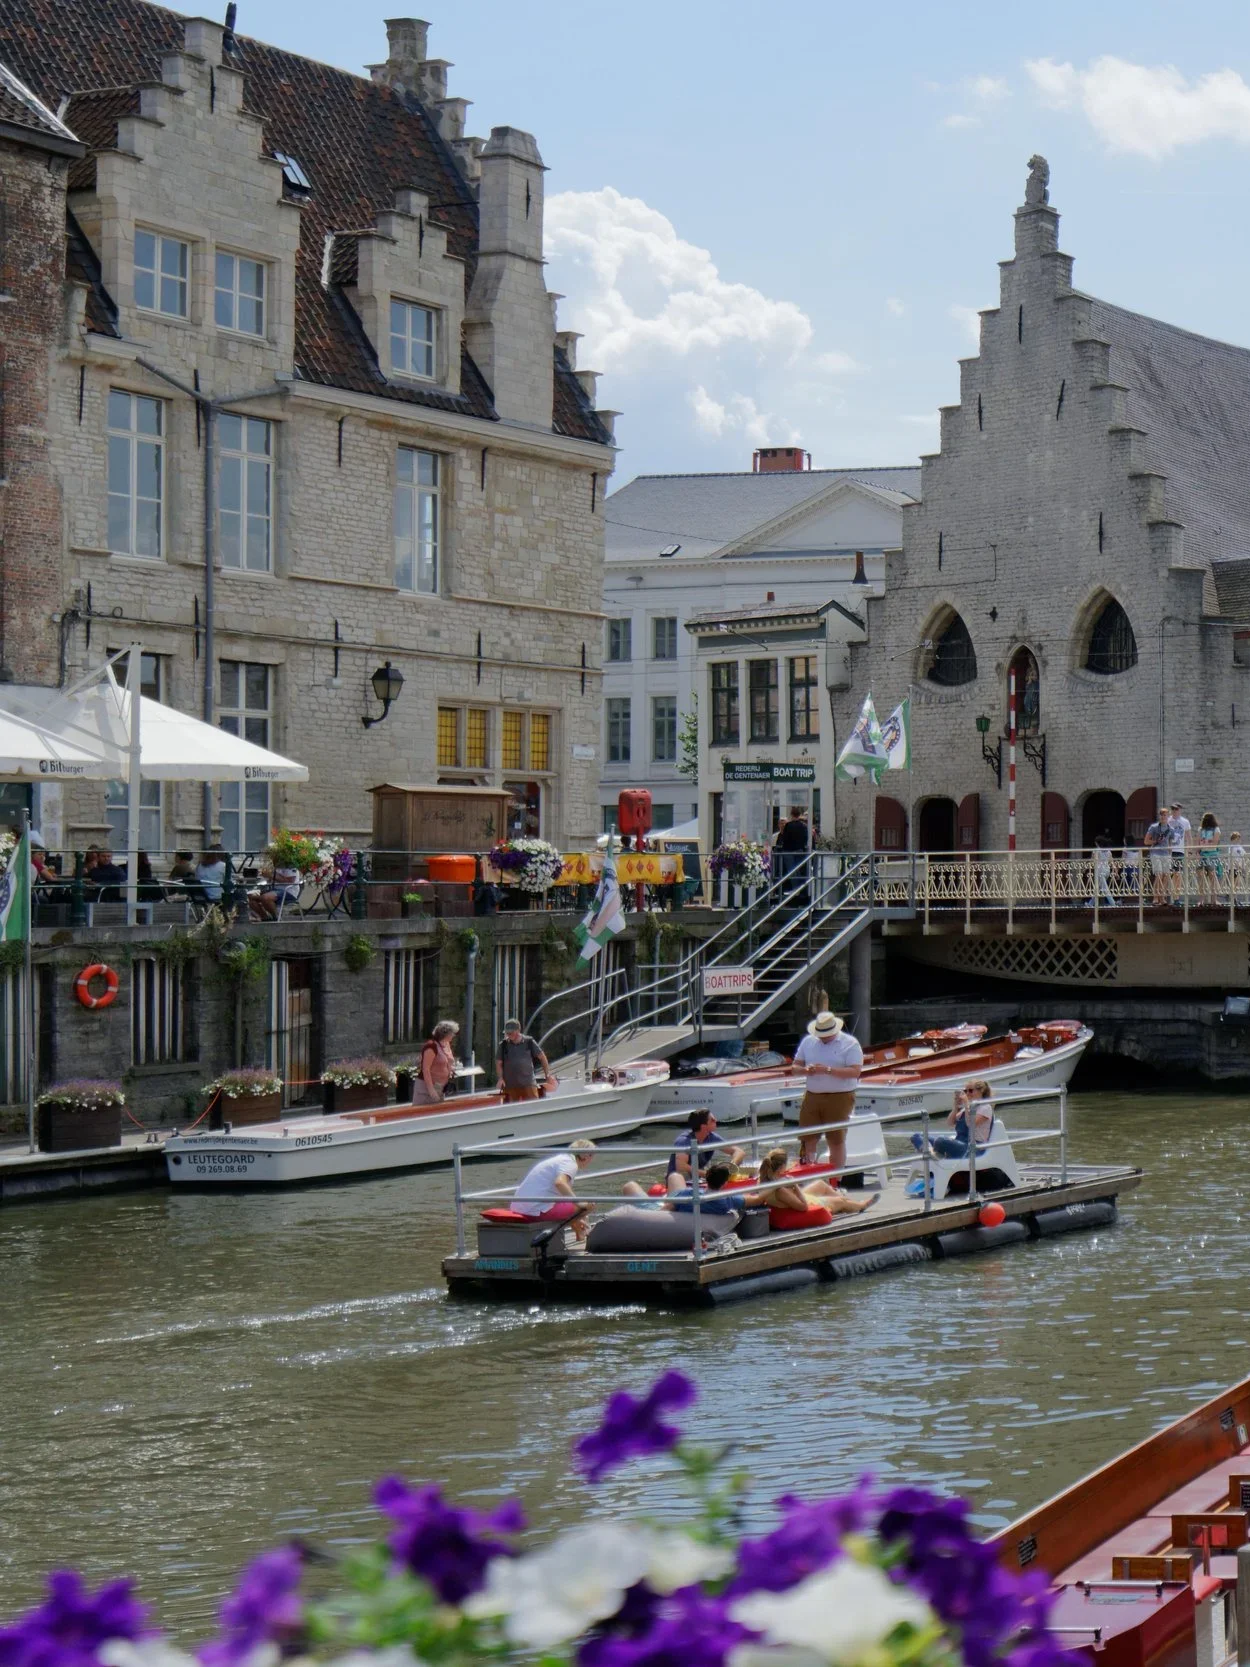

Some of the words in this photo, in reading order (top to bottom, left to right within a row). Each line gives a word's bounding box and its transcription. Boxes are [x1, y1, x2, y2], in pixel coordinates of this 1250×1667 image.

[50, 761, 84, 775] Bitburger
[773, 767, 794, 777] BOAT
[796, 768, 813, 778] TRIP
[187, 1154, 256, 1165] LEUTEGOARD
[196, 1165, 207, 1174] 09
